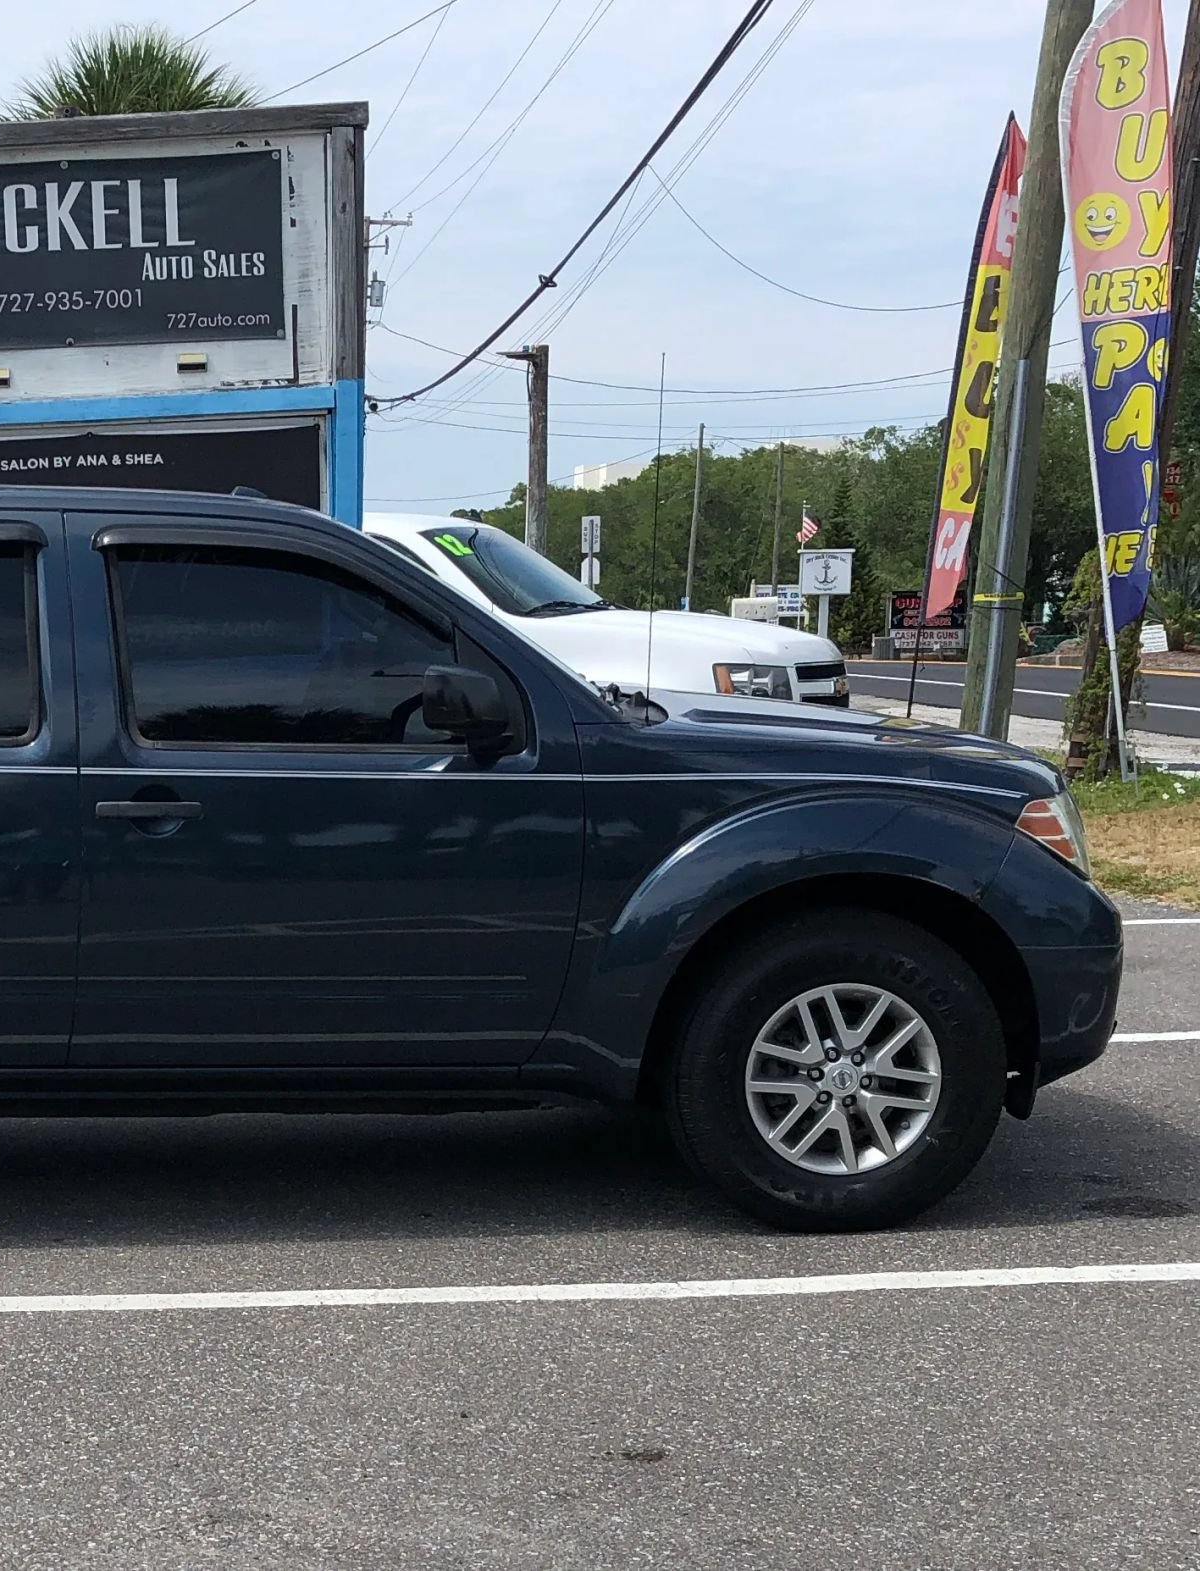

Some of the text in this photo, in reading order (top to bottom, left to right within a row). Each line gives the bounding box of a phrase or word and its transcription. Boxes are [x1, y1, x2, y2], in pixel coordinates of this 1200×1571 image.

[142, 249, 265, 281] AUTO SALES
[167, 312, 270, 329] 727auto.com
[0, 453, 164, 471] SALON BY ANA & SHEA
[433, 533, 475, 557] 12
[895, 631, 917, 640] CASH
[936, 631, 959, 640] GUNS
